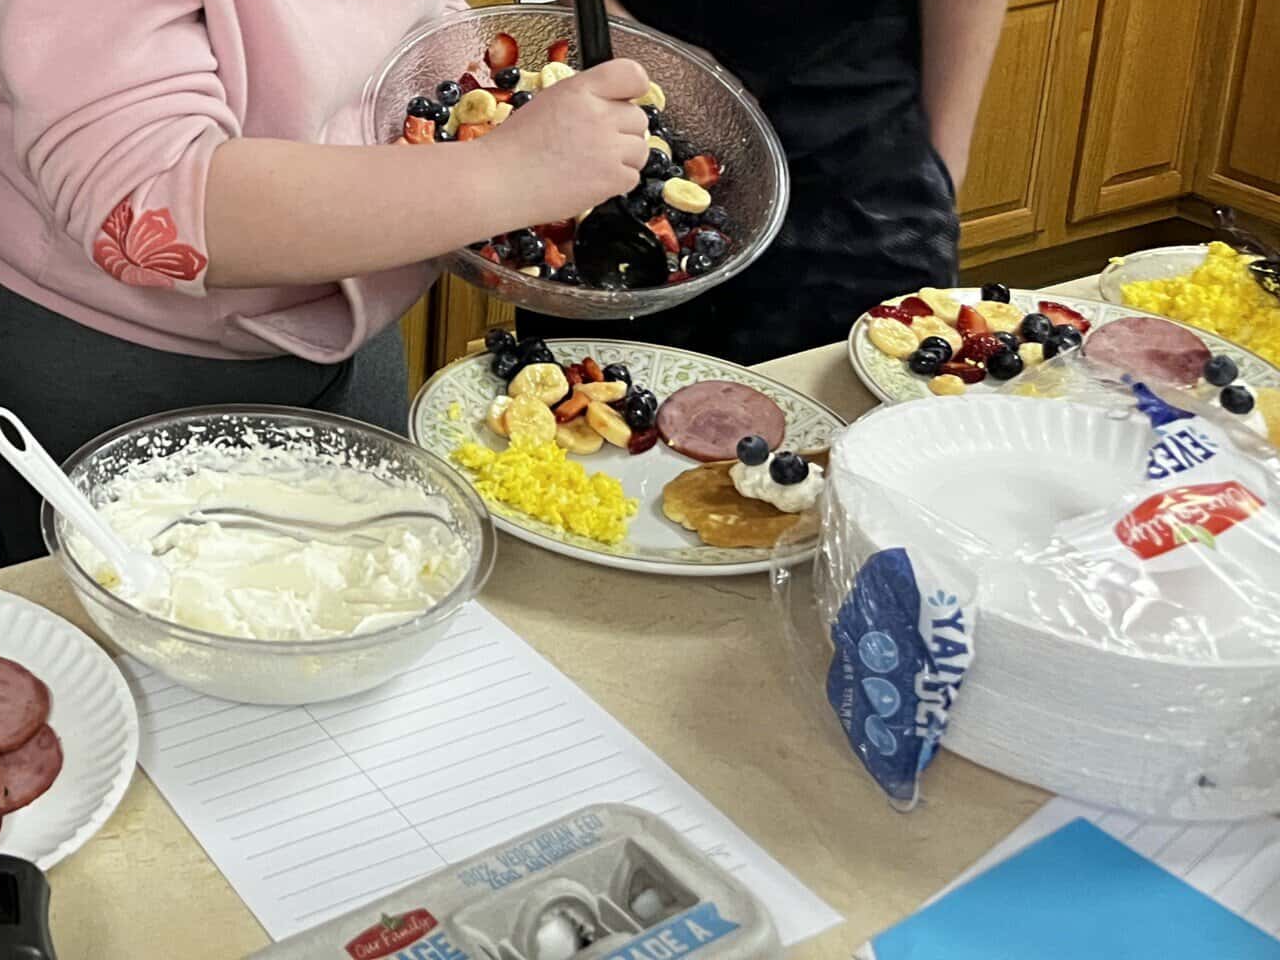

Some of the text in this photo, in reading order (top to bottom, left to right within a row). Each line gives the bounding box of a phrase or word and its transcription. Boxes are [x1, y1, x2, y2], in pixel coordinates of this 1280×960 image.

[1124, 505, 1210, 547] Faily
[354, 914, 432, 957] Our Family
[684, 917, 713, 943] A
